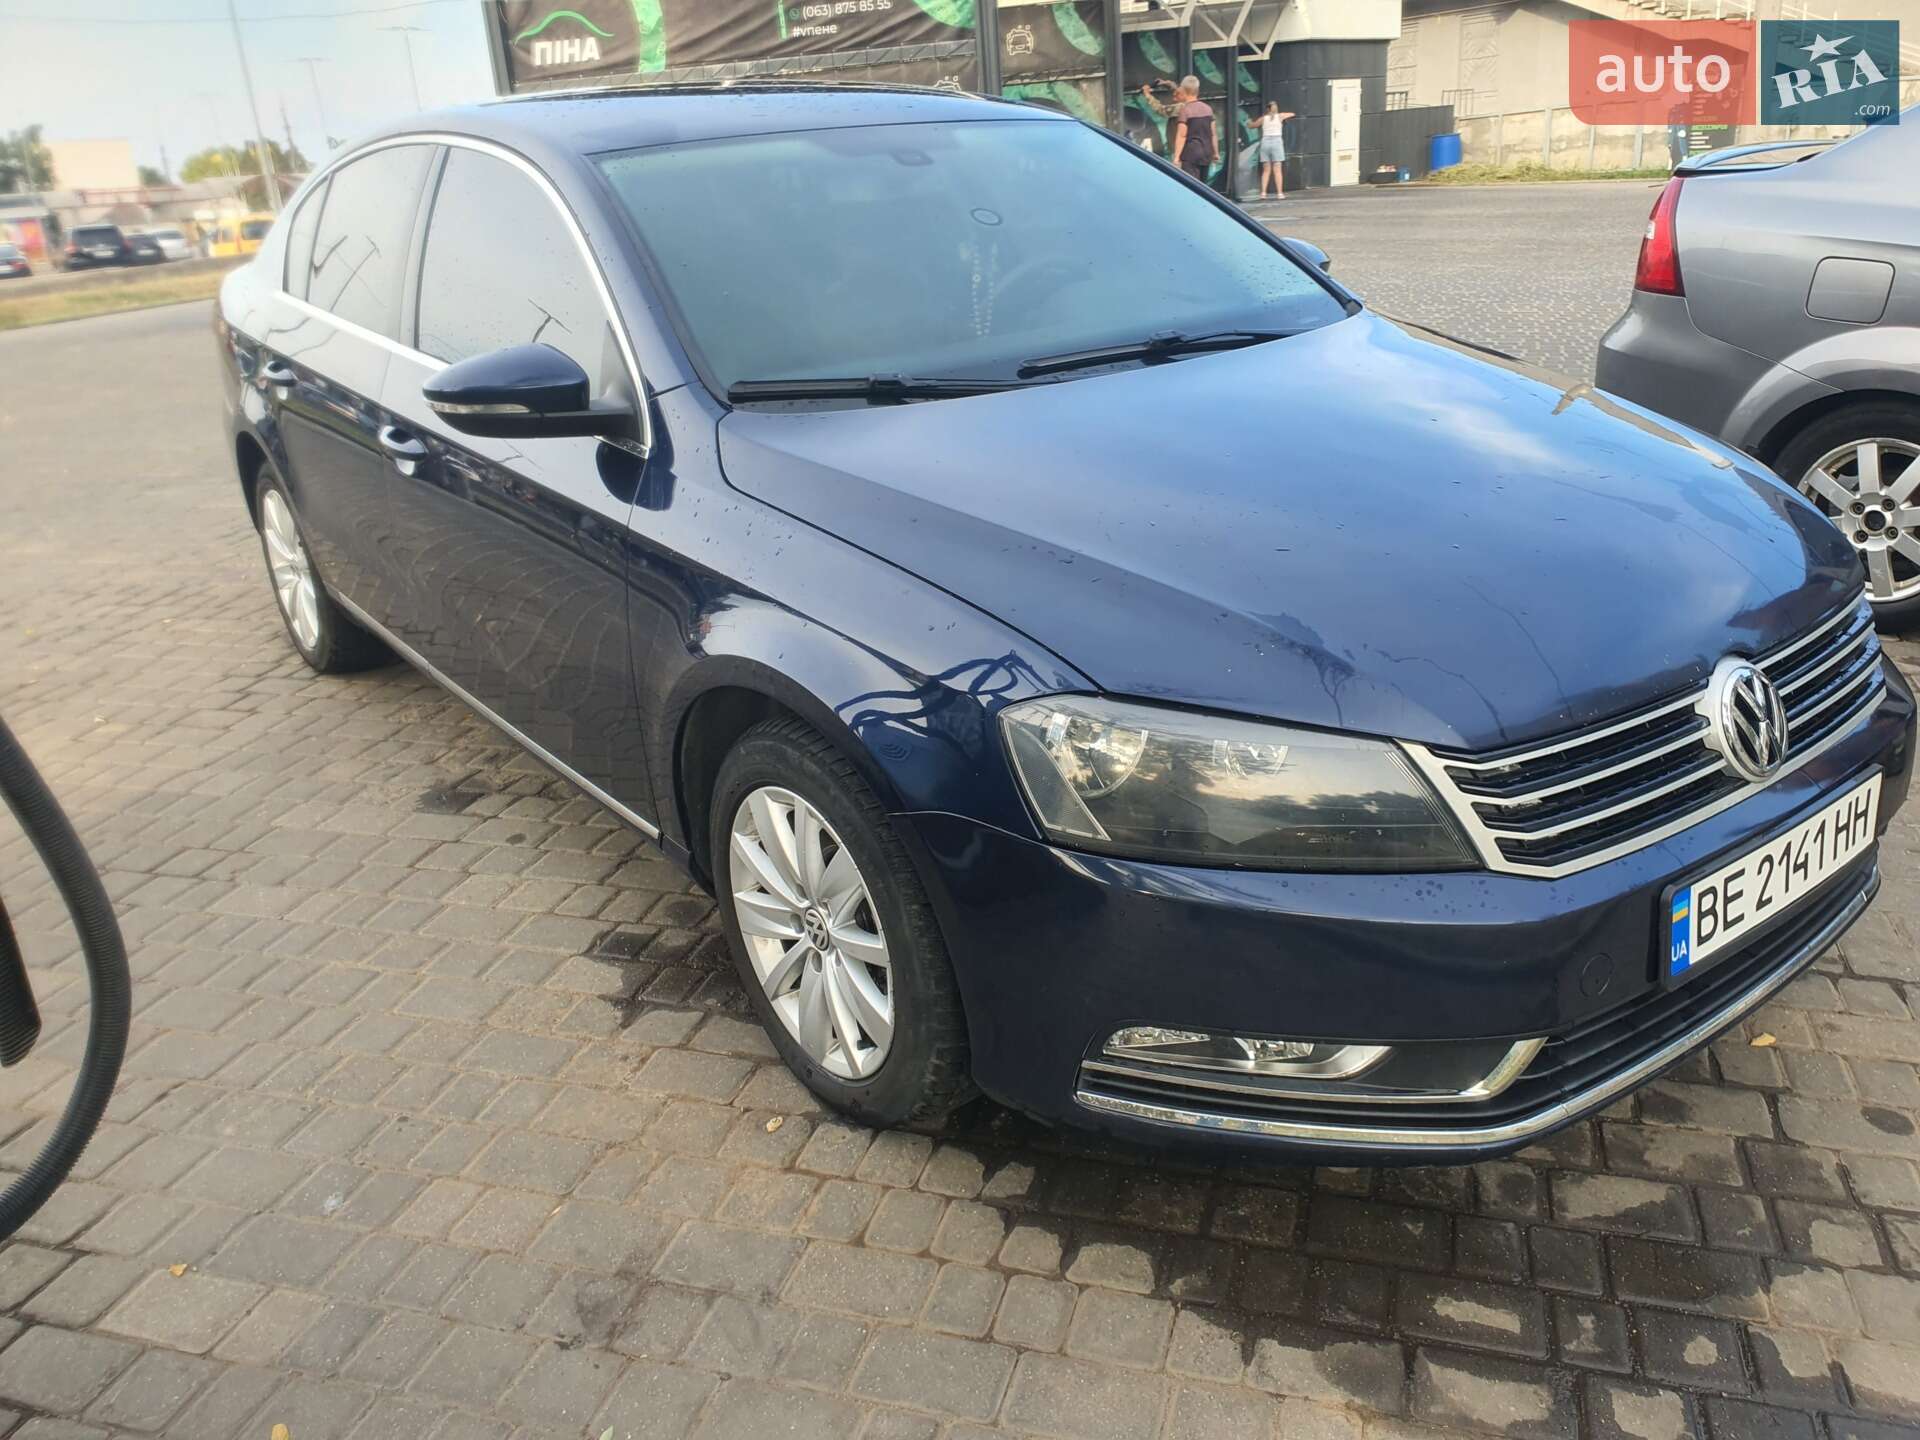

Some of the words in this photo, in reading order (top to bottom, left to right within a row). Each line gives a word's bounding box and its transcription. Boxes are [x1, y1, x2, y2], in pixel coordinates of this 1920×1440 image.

[802, 3, 832, 20] (063)
[835, 1, 857, 14] 875
[859, 0, 874, 11] 85
[534, 37, 600, 66] ПІНА
[1696, 867, 1746, 947] BE
[1755, 819, 1825, 913] 2141
[1833, 788, 1872, 861] HH
[1671, 940, 1687, 962] UA
